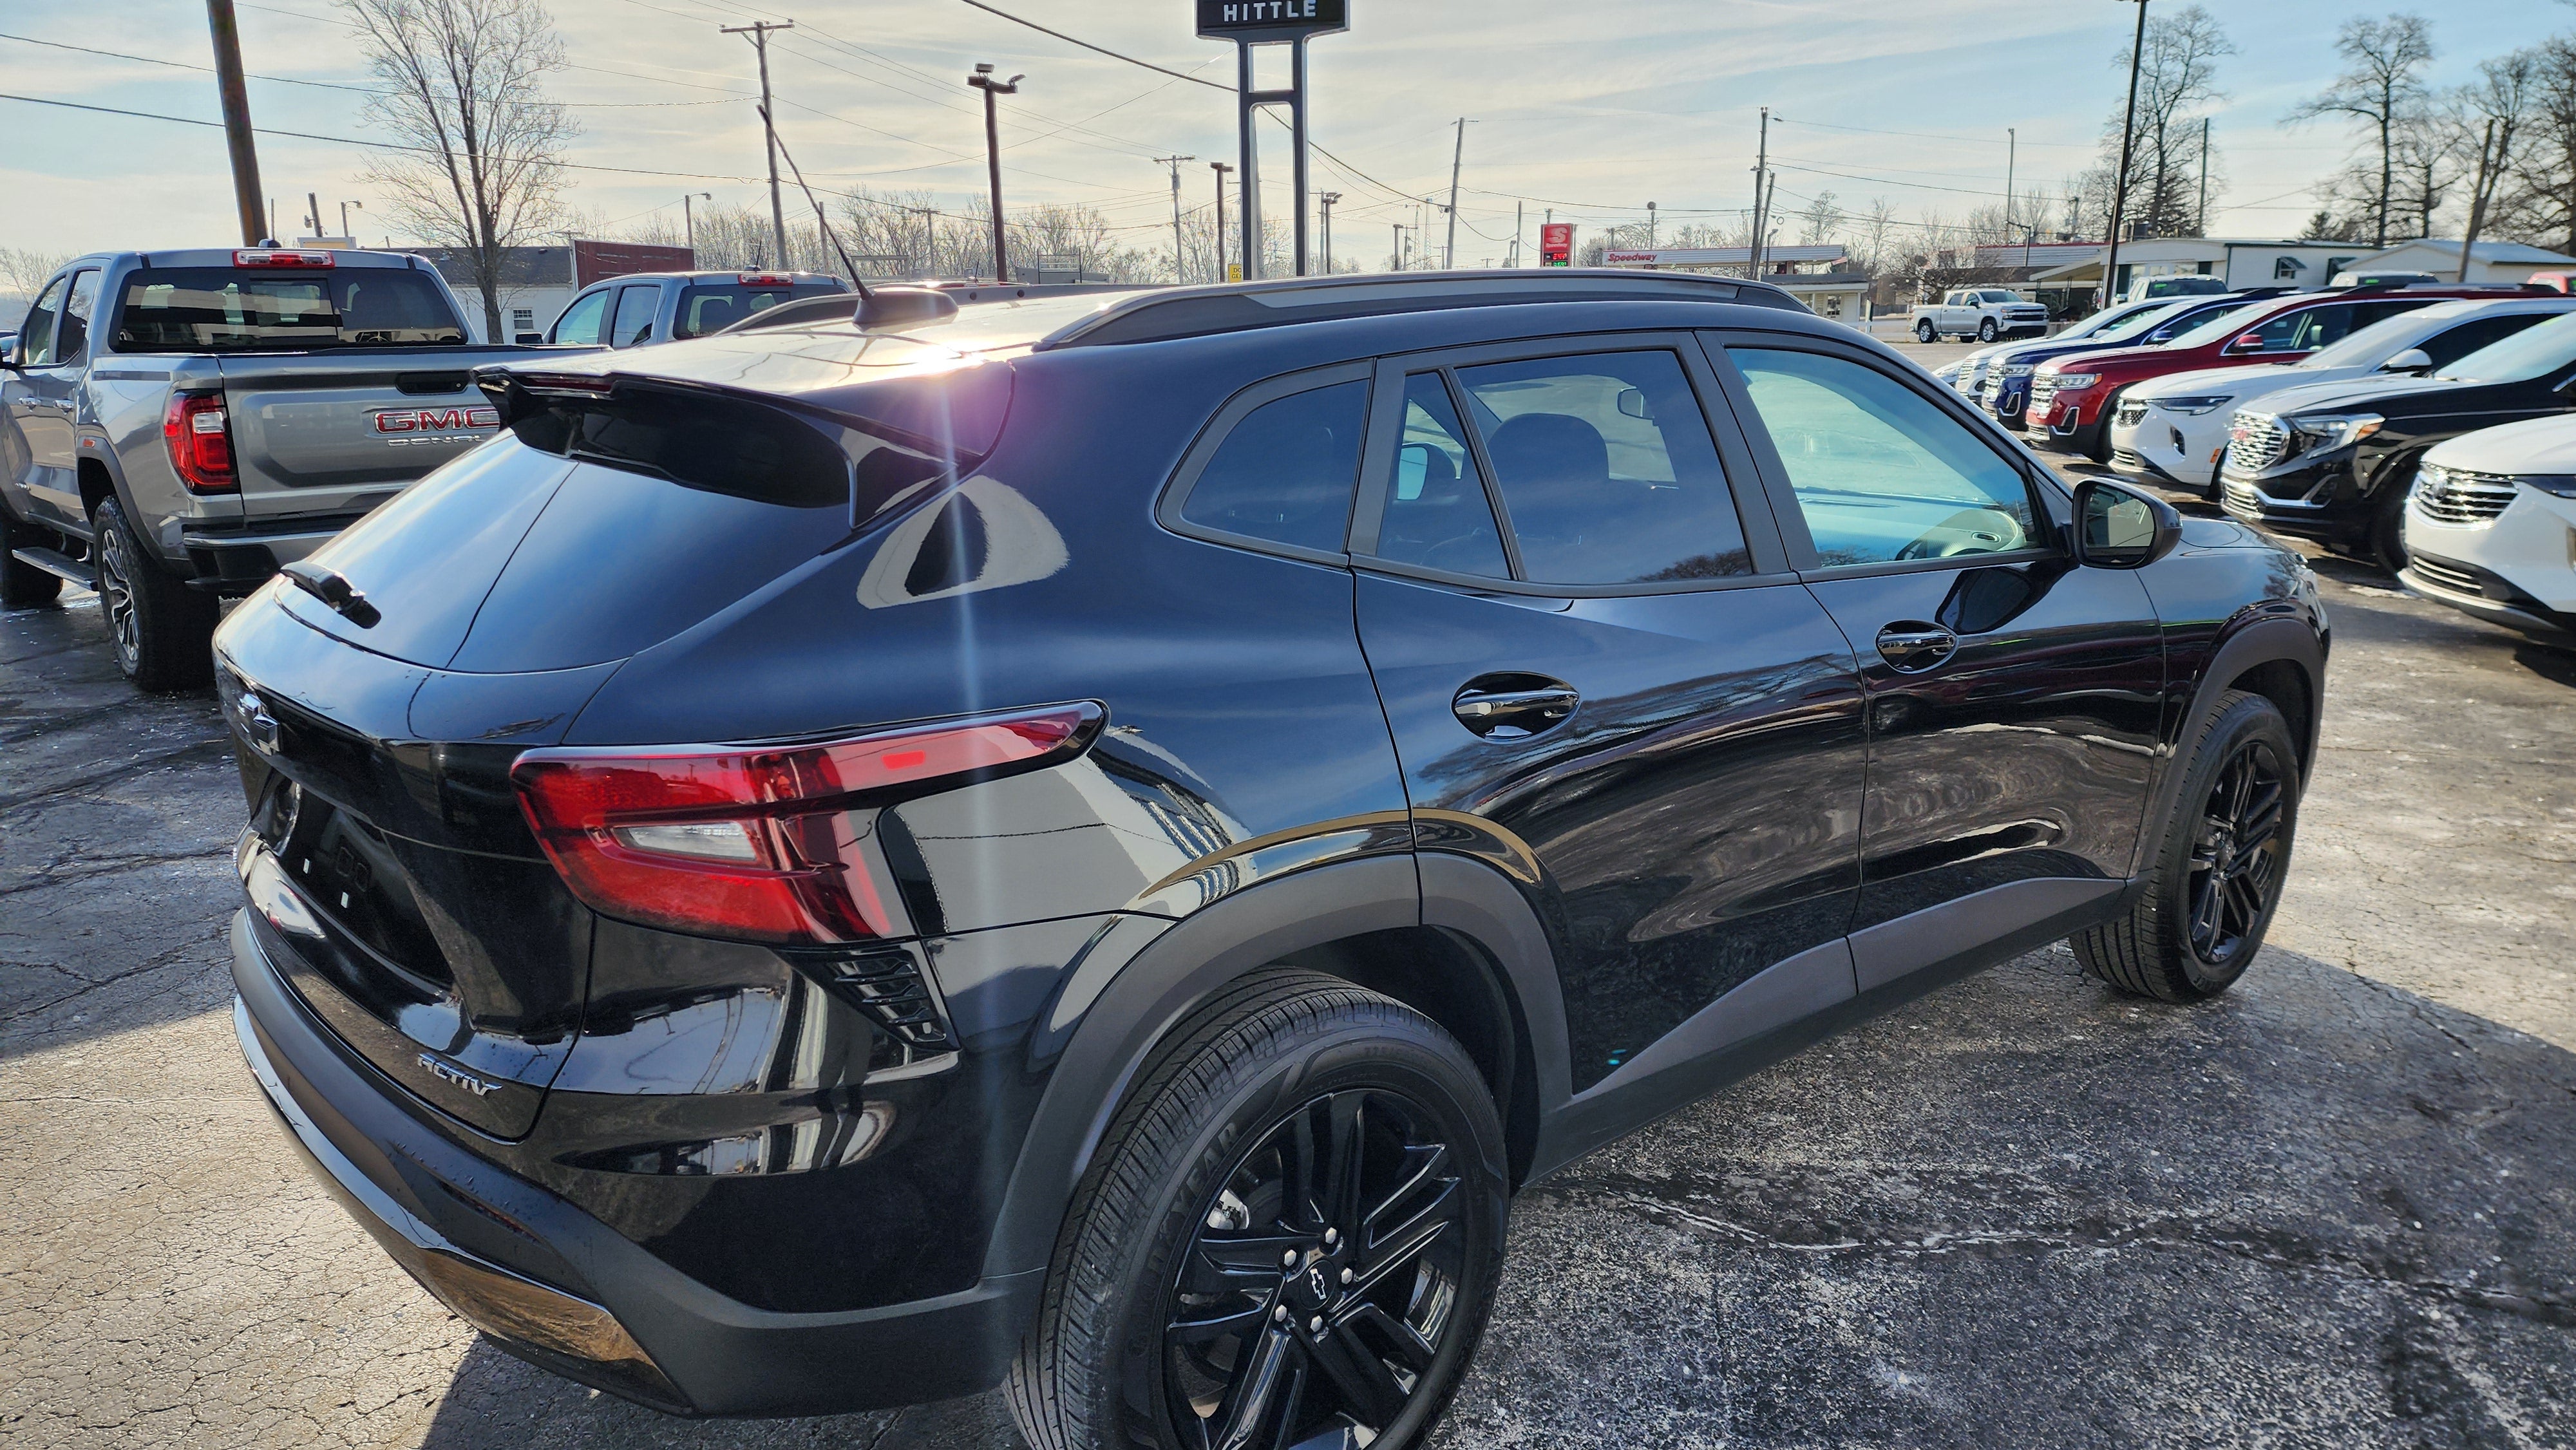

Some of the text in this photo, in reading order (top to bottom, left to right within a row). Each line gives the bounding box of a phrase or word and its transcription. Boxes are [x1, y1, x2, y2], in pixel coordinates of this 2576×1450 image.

[1223, 0, 1317, 22] HITTLE
[1607, 253, 1658, 263] Speedway
[374, 408, 500, 433] GMC
[388, 435, 486, 447] DENAL
[417, 1052, 503, 1097] ACTIV
